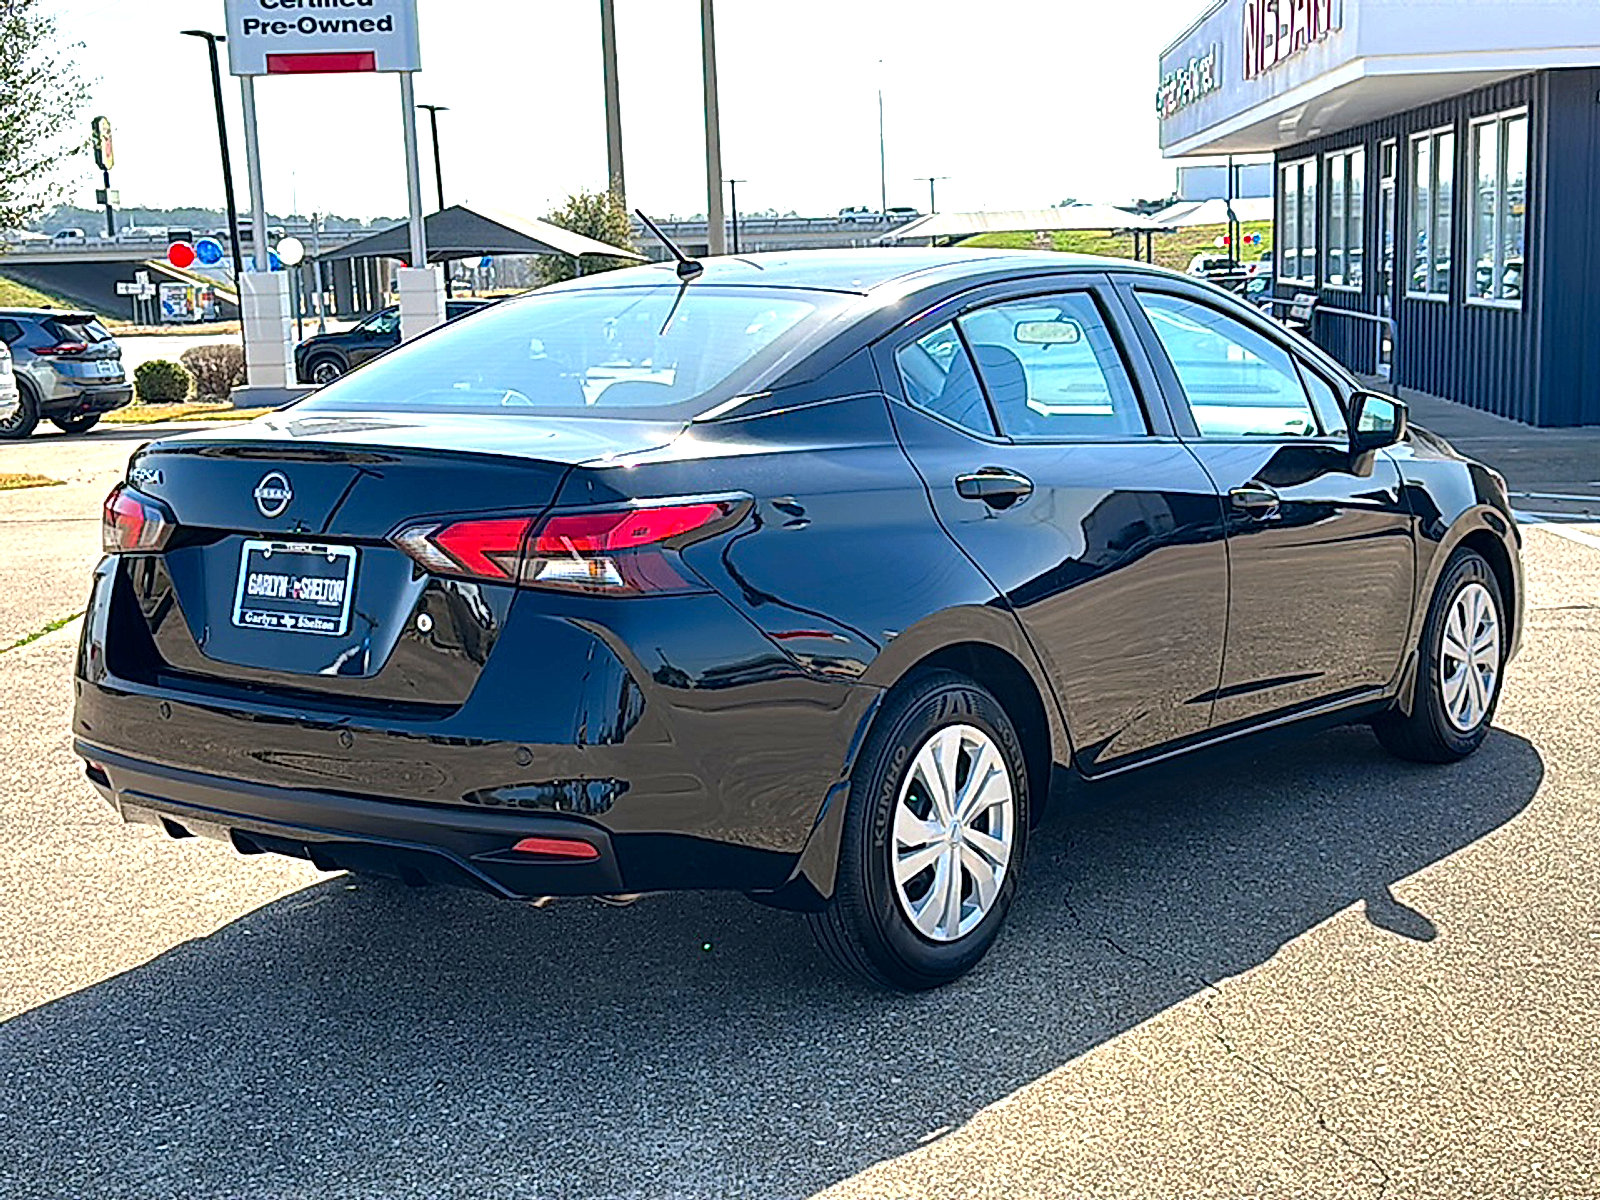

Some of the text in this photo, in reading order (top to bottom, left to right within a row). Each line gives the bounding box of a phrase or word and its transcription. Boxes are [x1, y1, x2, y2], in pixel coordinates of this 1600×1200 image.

[243, 15, 393, 35] Pre-Owned
[299, 577, 345, 602] SHELTON
[874, 745, 907, 847] KUMHO
